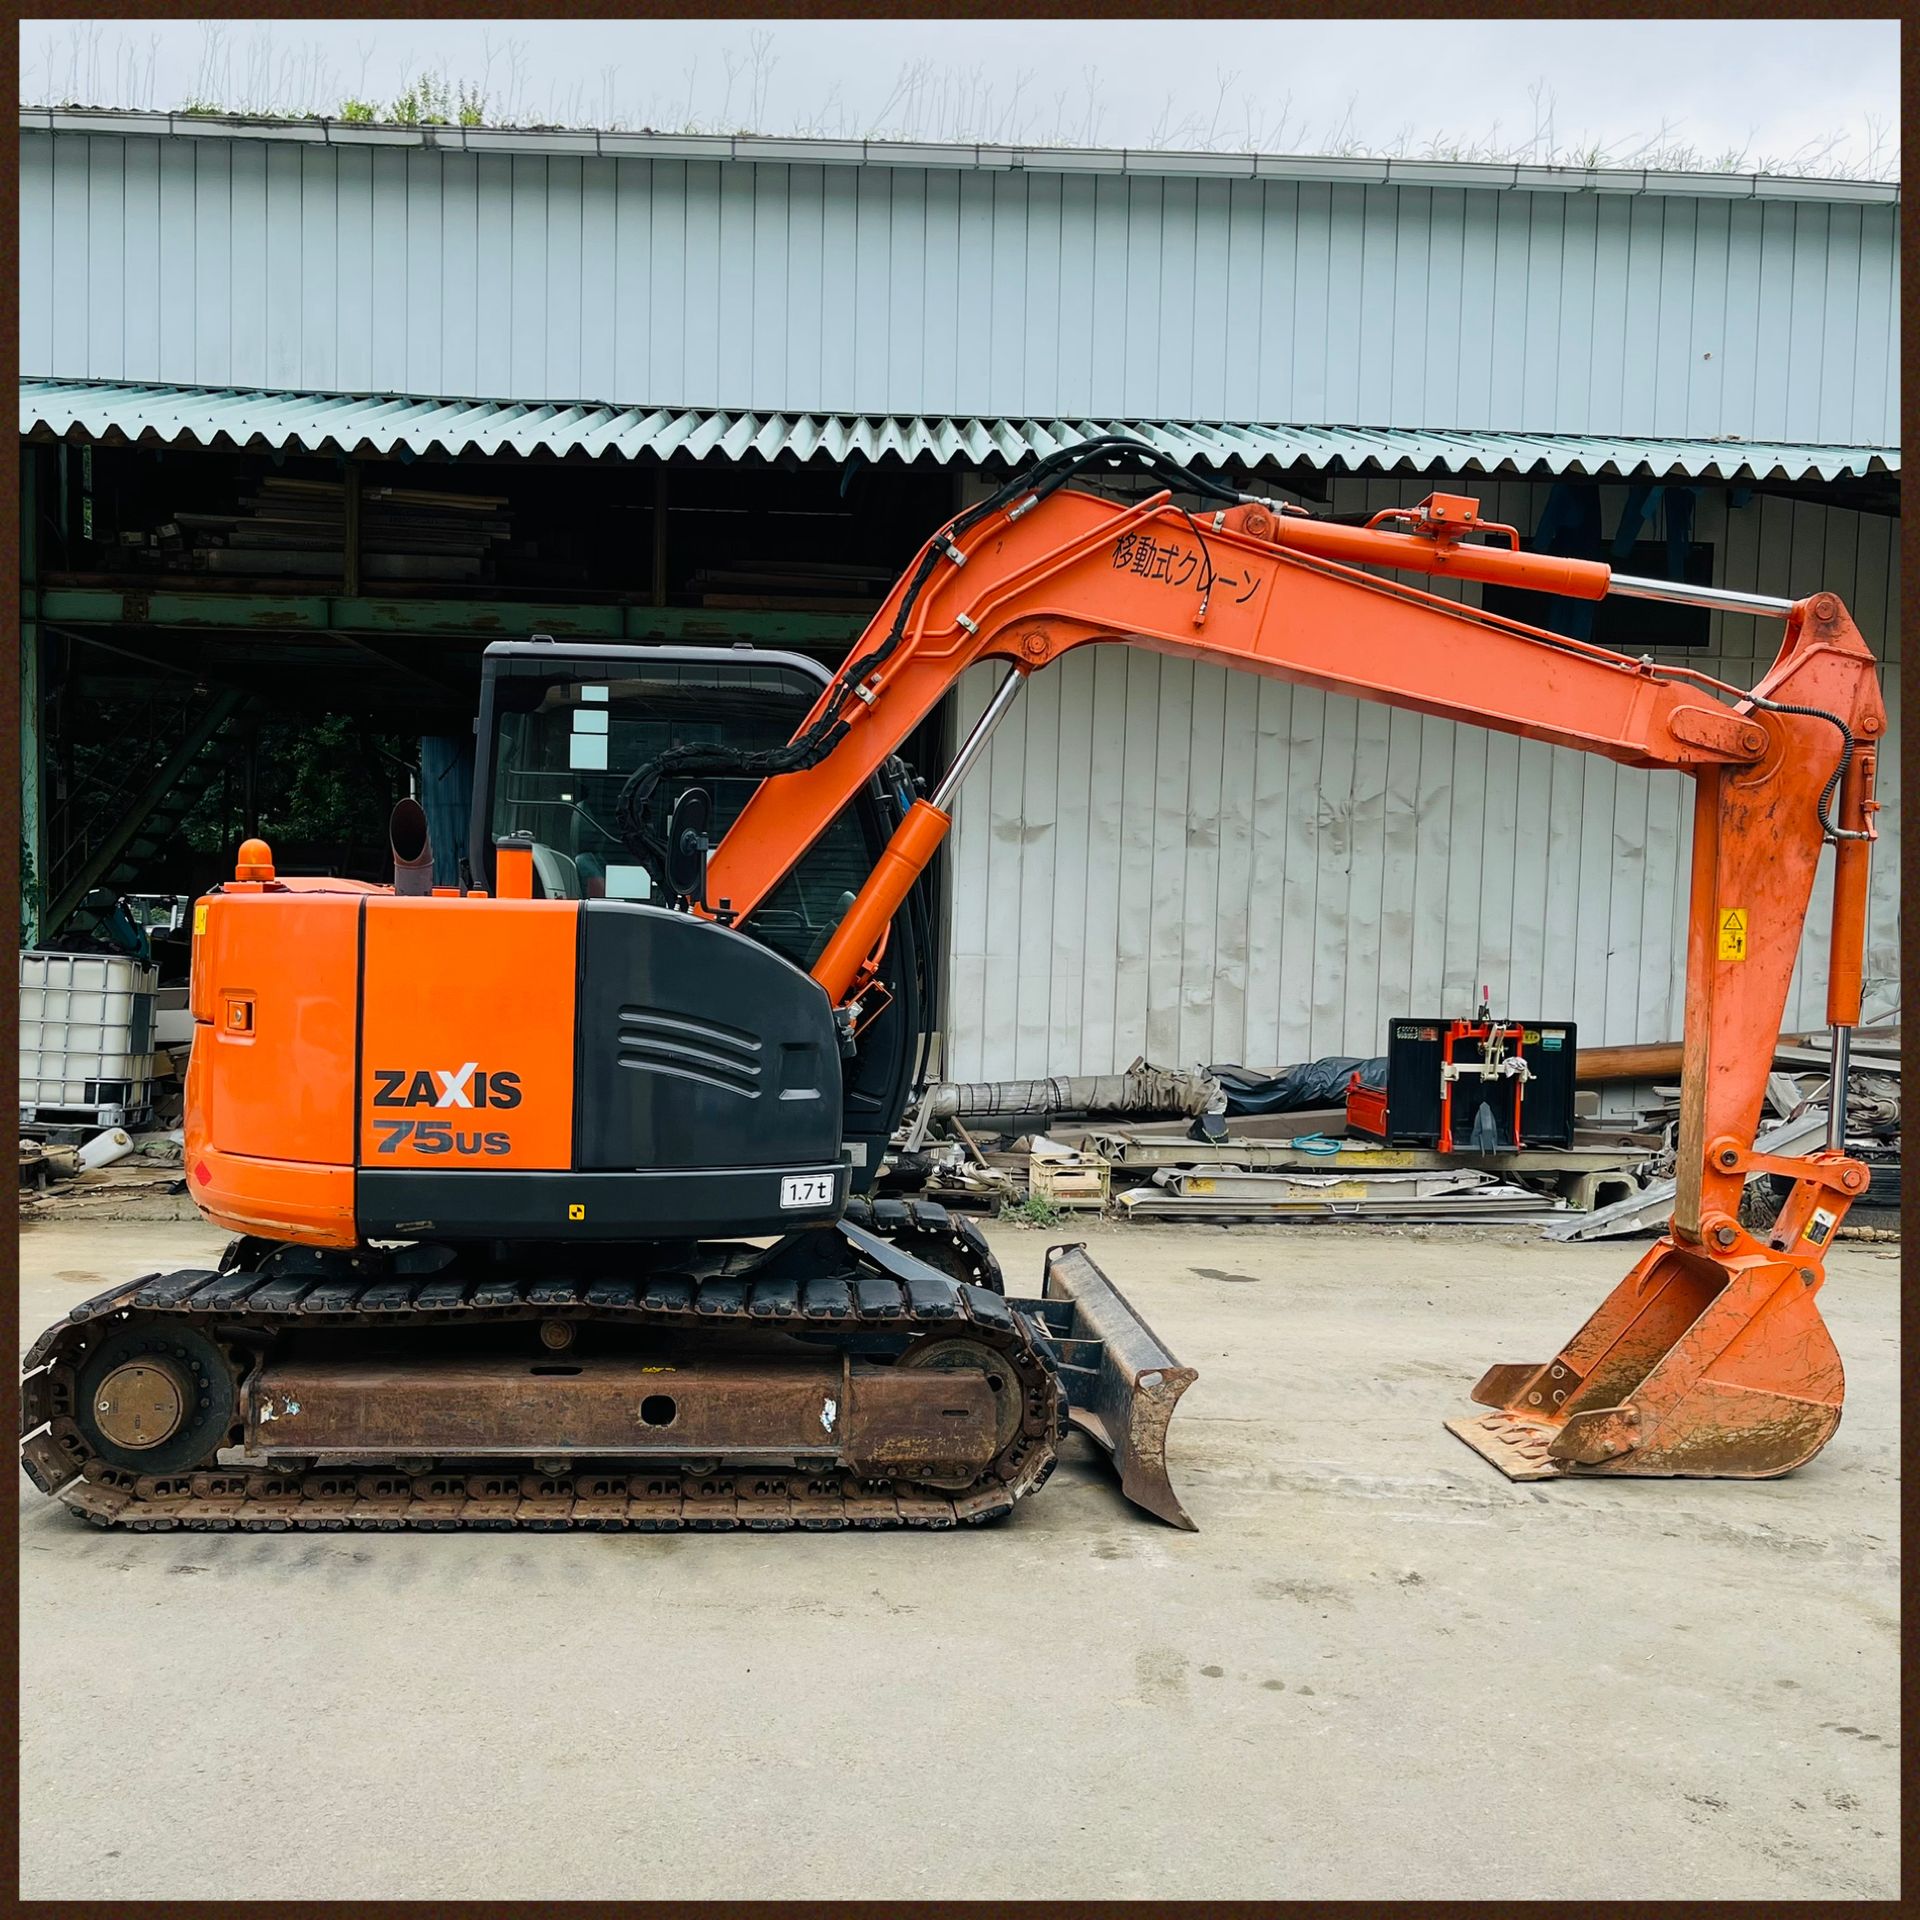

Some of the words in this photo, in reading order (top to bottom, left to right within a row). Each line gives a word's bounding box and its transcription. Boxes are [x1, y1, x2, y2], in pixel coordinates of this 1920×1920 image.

[1112, 532, 1261, 603] 移動式クレーン
[374, 1062, 522, 1109] ZAXIS
